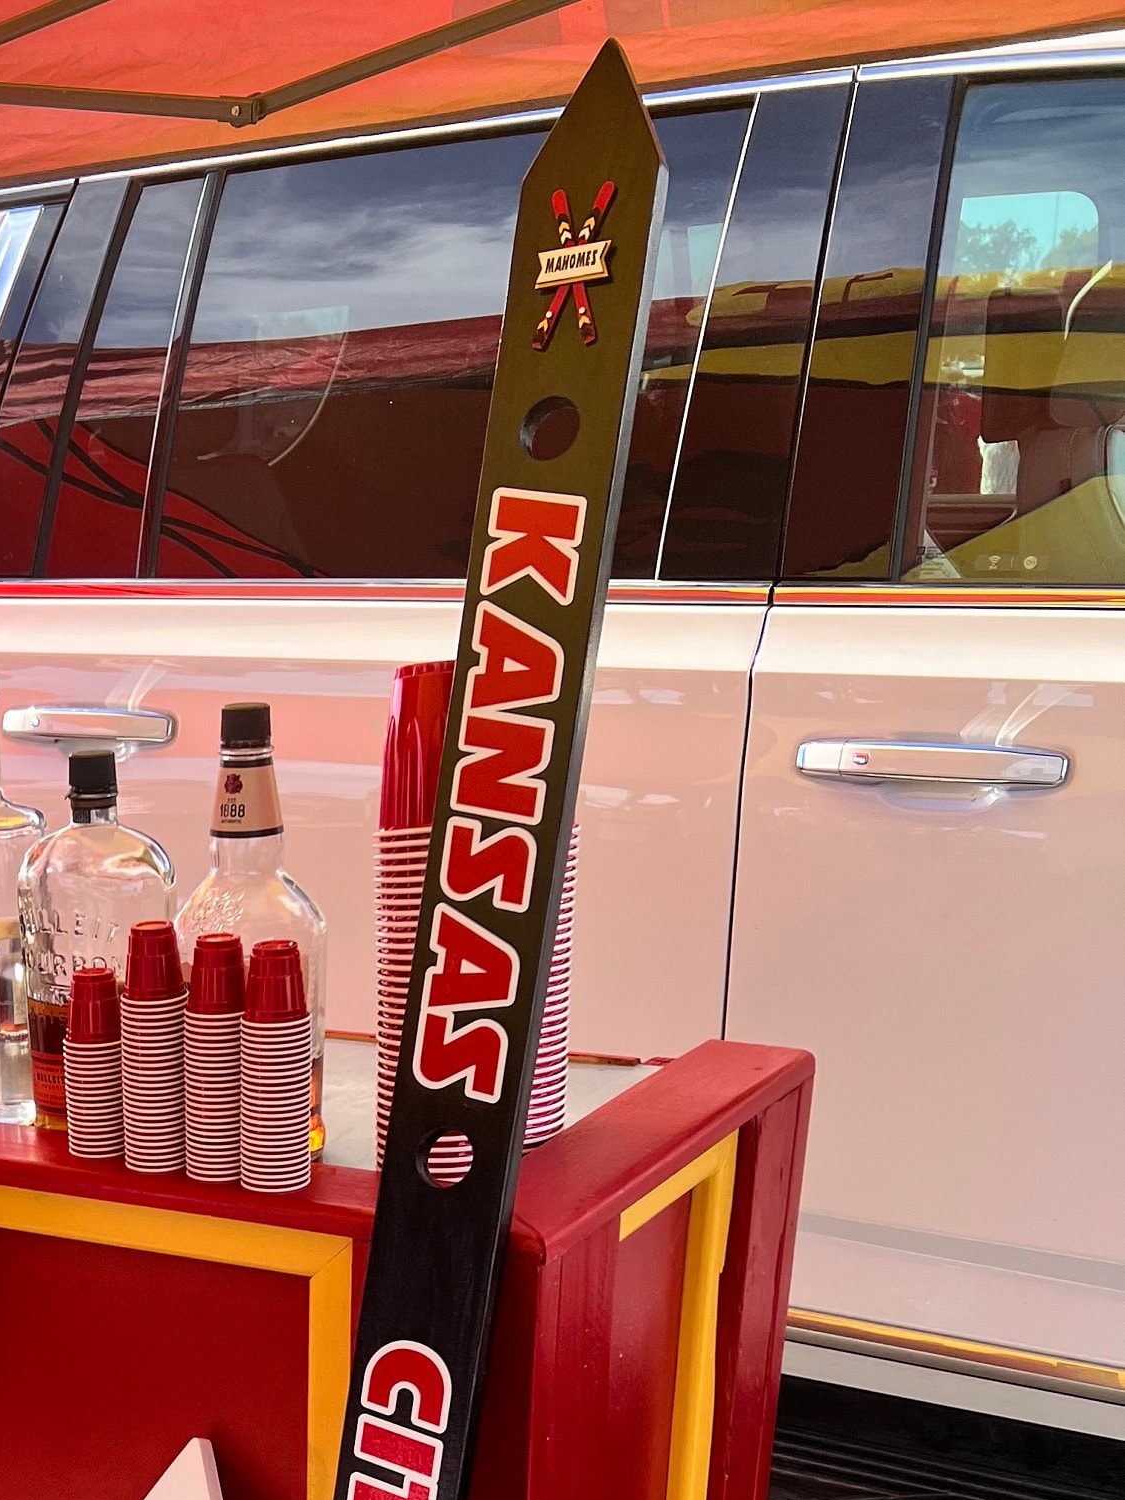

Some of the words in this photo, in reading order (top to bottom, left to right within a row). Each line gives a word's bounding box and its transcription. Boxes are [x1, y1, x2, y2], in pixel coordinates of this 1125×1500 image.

[545, 249, 598, 274] MAHOMES
[412, 487, 587, 1103] KANSAS
[220, 804, 246, 818] 1888
